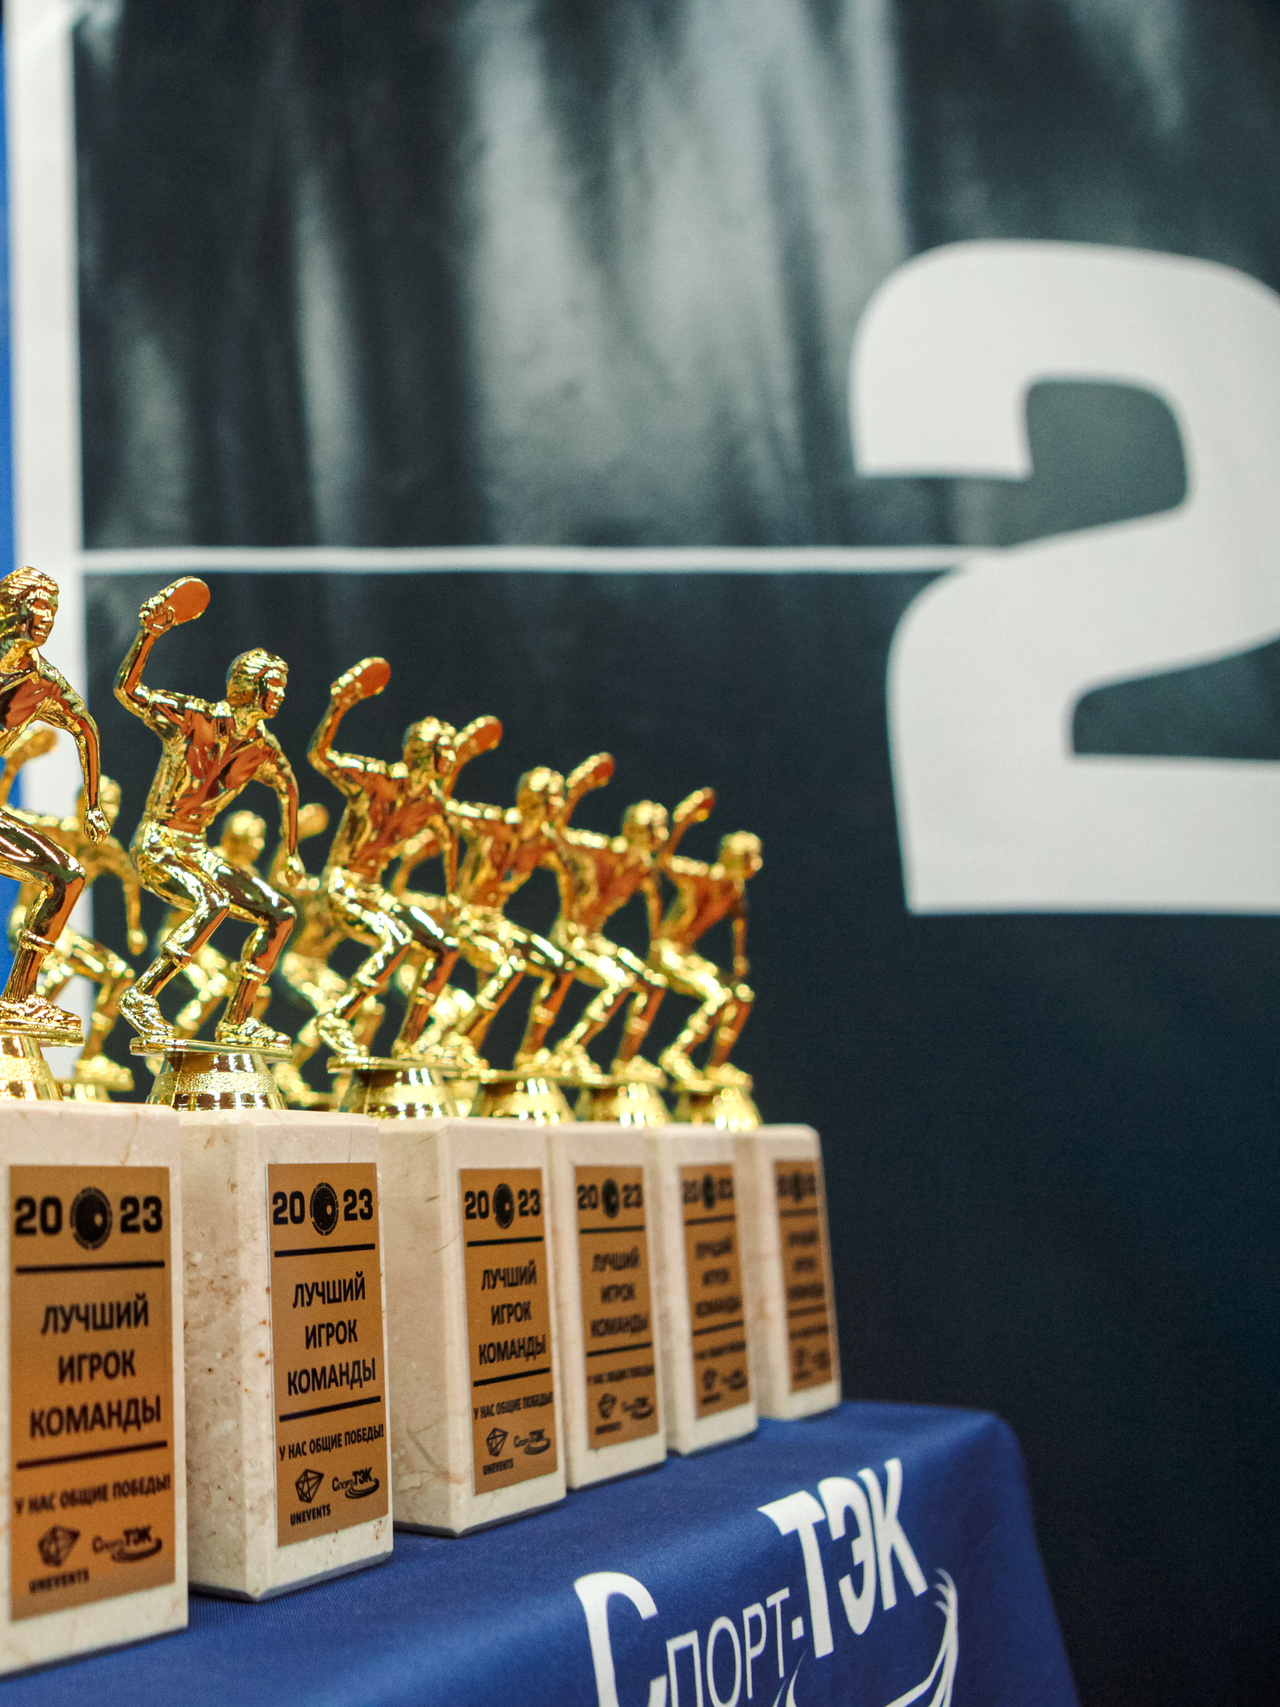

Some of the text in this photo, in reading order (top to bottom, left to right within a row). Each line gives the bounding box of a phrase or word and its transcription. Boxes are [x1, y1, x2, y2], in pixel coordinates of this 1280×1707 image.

[848, 238, 1280, 915] 2
[14, 1195, 163, 1236] 20 23
[272, 1188, 373, 1225] 20 23
[465, 1188, 541, 1220] 20 23
[292, 1271, 365, 1309] ЛУЧШИЙ
[481, 1259, 537, 1291] ЛУЧШИЙ
[41, 1292, 149, 1335] ЛУЧШИЙ
[491, 1301, 532, 1326] ИГРОК
[305, 1319, 358, 1350] ИГРОК
[478, 1334, 546, 1366] КОМАНДЫ
[58, 1349, 136, 1384] ИГРОК
[287, 1357, 376, 1396] КОМАНДЫ
[29, 1394, 161, 1438] КОМАНДЫ
[279, 1423, 384, 1461] У НАС ОБЩИЕ ПОБЕДЫ!
[290, 1503, 331, 1526] UNEVENTS
